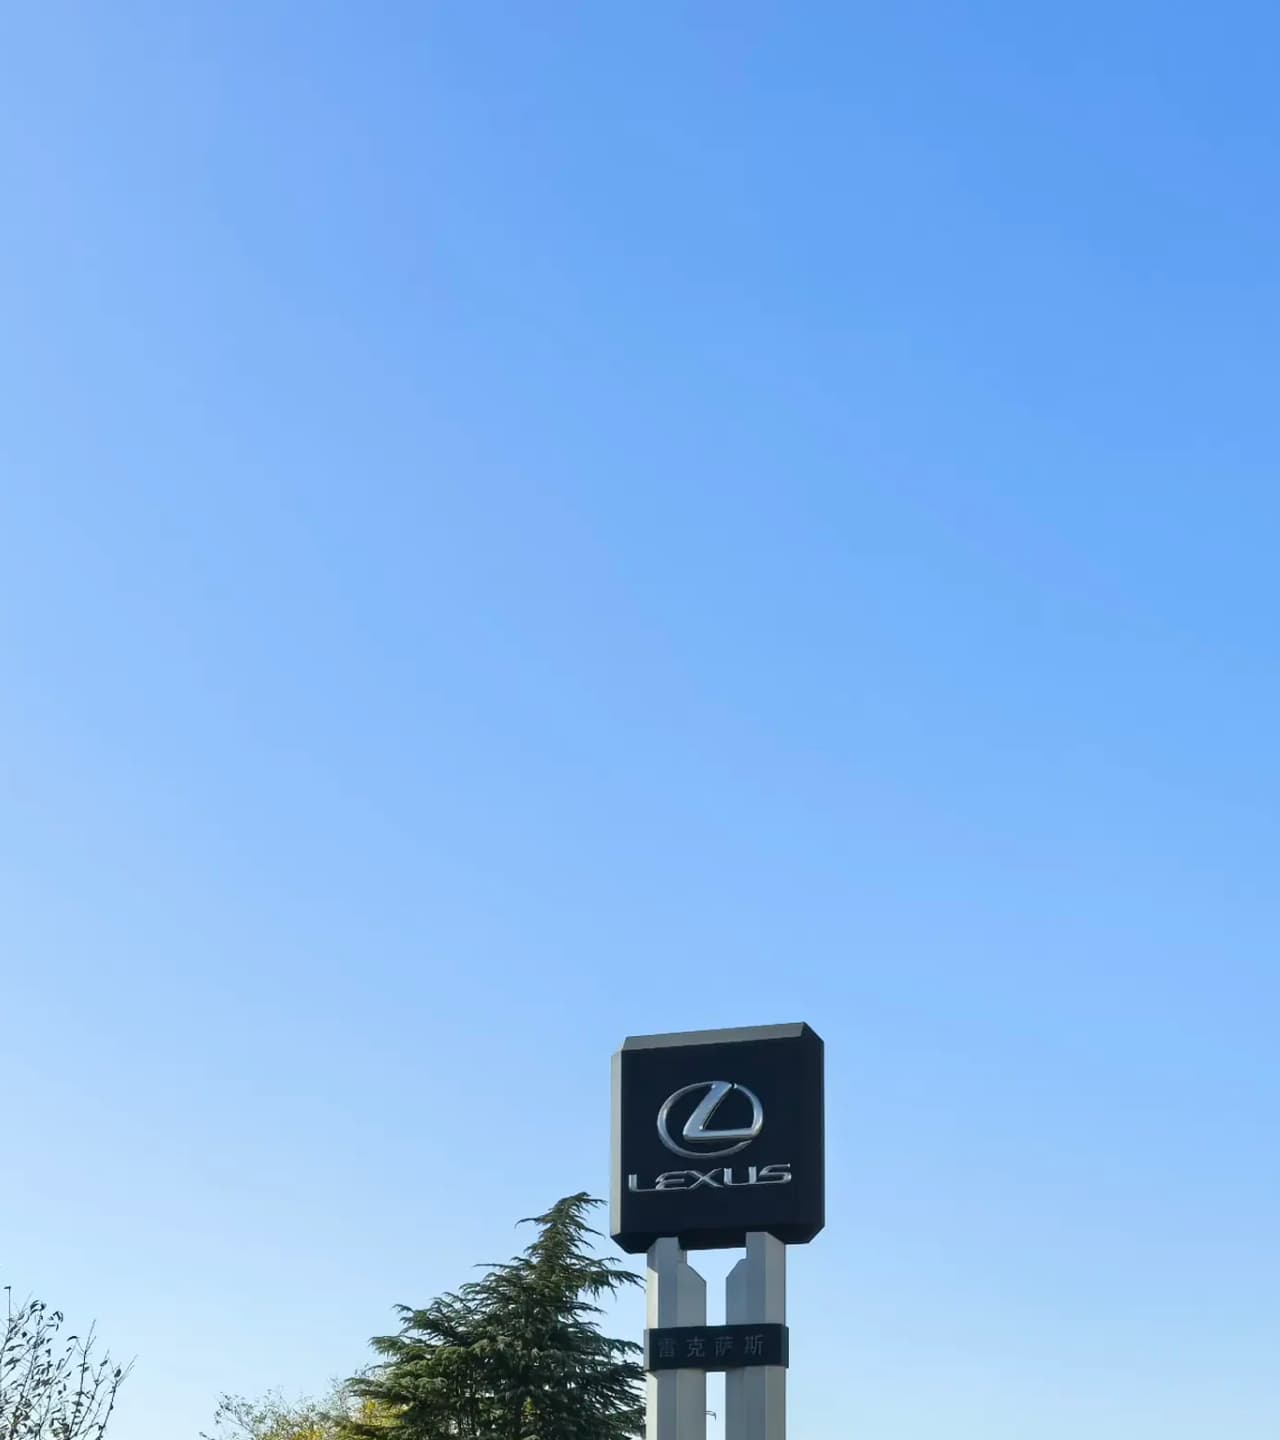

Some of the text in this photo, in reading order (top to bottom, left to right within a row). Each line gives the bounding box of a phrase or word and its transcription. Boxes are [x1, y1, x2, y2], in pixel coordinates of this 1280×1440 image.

[628, 1163, 792, 1193] LEXUS
[657, 1333, 765, 1359] 雷克萨斯
